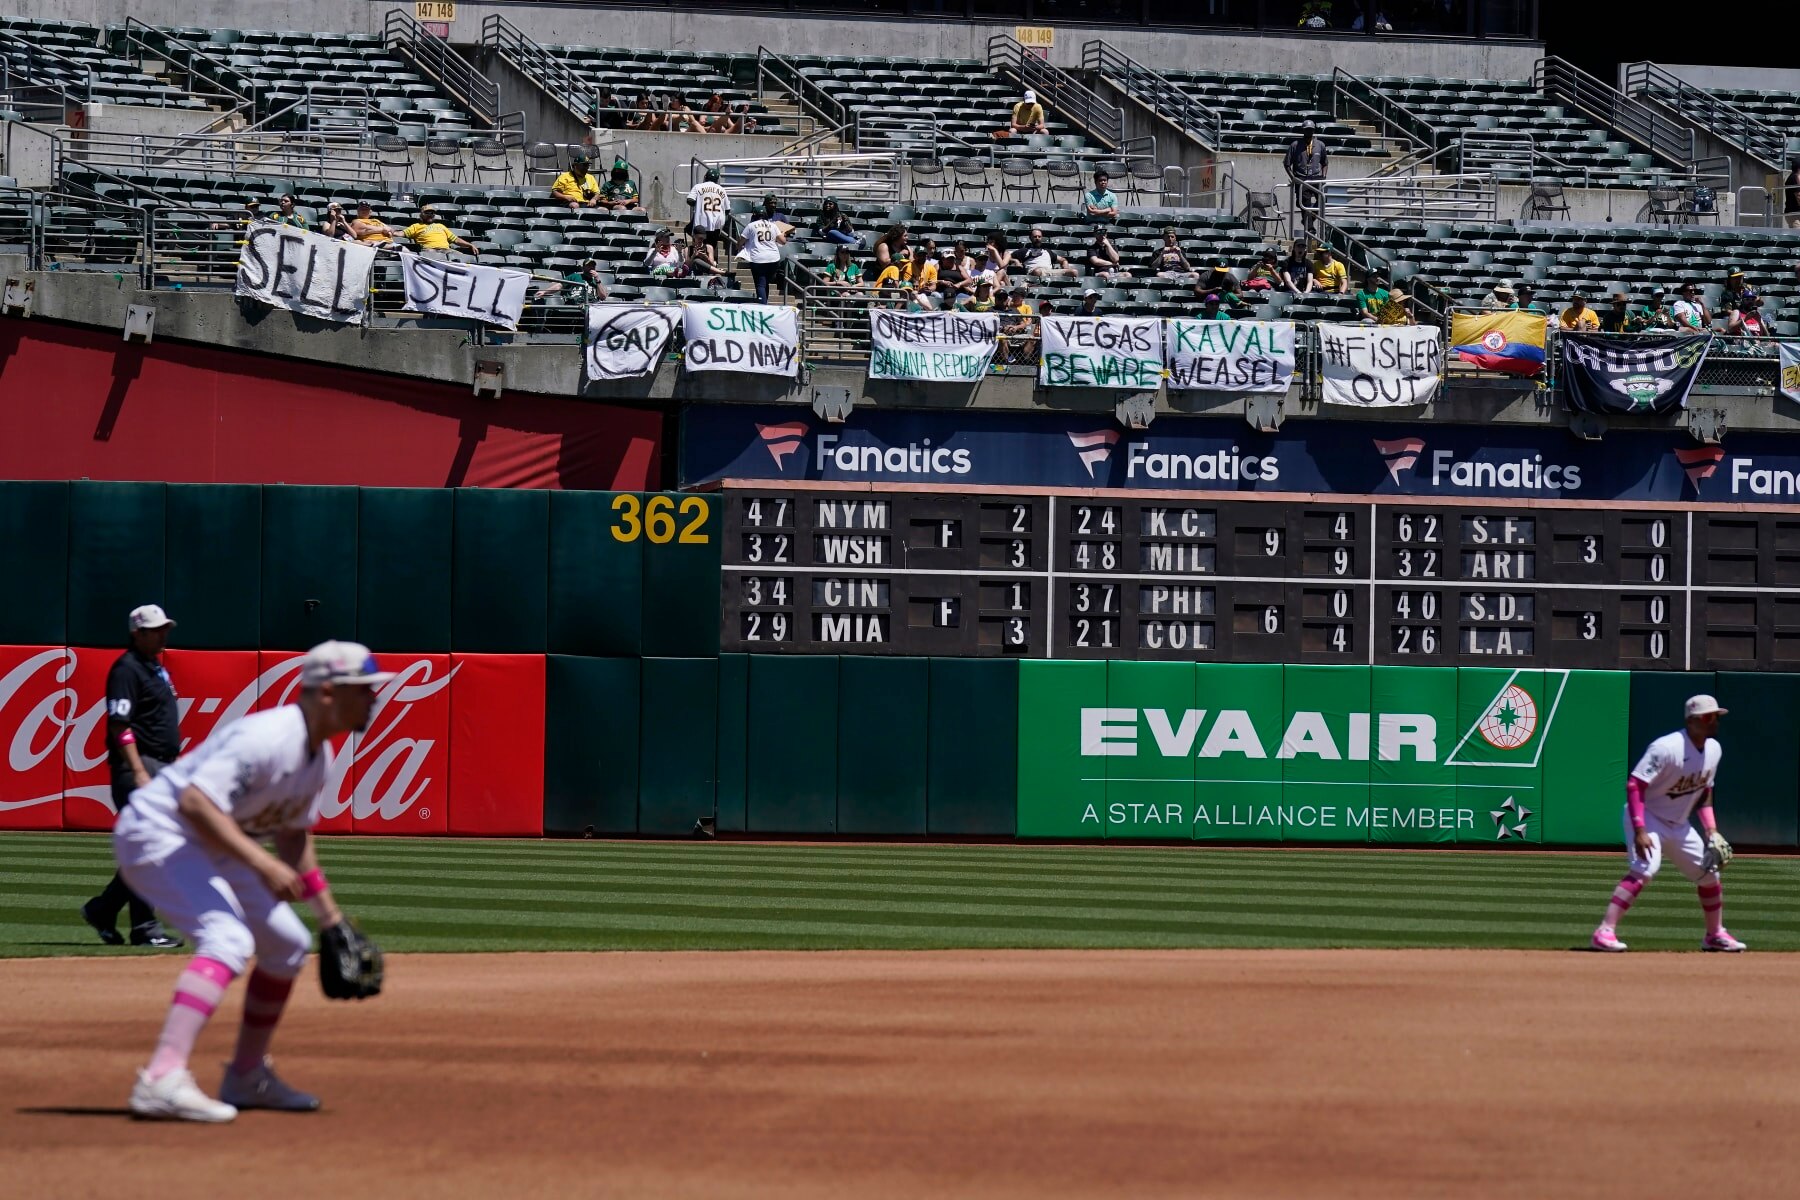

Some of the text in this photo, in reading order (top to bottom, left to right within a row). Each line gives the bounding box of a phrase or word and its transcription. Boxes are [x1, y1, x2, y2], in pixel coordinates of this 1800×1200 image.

[417, 2, 453, 18] 147 148
[1017, 29, 1052, 44] 148 149
[703, 196, 721, 213] 22
[757, 230, 772, 242] 20
[241, 227, 361, 315] SELL
[409, 259, 514, 322] SELL
[707, 307, 775, 334] SINK
[877, 314, 998, 345] OVERTHROW
[1055, 320, 1151, 352] VEGAS
[606, 325, 660, 351] GAP
[1176, 321, 1285, 355] KAVAL
[688, 339, 797, 370] OLD NAVY
[873, 346, 929, 378] BANANA
[1045, 353, 1162, 386] BEWARE
[1170, 357, 1285, 386] WEASEL
[1352, 373, 1421, 403] OUT
[817, 434, 972, 474] Fanatics
[1127, 442, 1280, 481] Fanatics
[1432, 450, 1582, 490] Fanatics
[610, 493, 710, 544] 362
[819, 500, 886, 529] NYM
[1012, 504, 1026, 532] 2
[1150, 507, 1206, 537] K.C.
[1334, 512, 1348, 540] 4
[942, 520, 953, 548] F
[1265, 528, 1279, 556] 9
[1472, 516, 1525, 544] S.F.
[1652, 520, 1665, 548] 0
[823, 535, 882, 564] WSH
[1012, 540, 1025, 568] 3
[1150, 543, 1206, 572] MIL
[1335, 547, 1348, 575] 9
[1583, 535, 1597, 563] 3
[1472, 551, 1525, 579] ARI
[1651, 554, 1665, 582] 0
[824, 578, 878, 607] CIN
[1011, 582, 1023, 610] 1
[1152, 586, 1202, 614] PHI
[1334, 589, 1347, 617] 0
[1469, 592, 1524, 621] S.D.
[1651, 596, 1664, 624] 0
[941, 598, 953, 626] F
[1265, 606, 1278, 634] 6
[1583, 612, 1596, 640] 3
[821, 614, 883, 643] MIA
[1011, 617, 1024, 645] 3
[1147, 620, 1207, 649] COL
[1332, 624, 1346, 652] 4
[1469, 626, 1524, 655] L.A.
[1651, 630, 1664, 658] 0
[1081, 803, 1474, 829] A STAR ALLIANCE MEMBER
